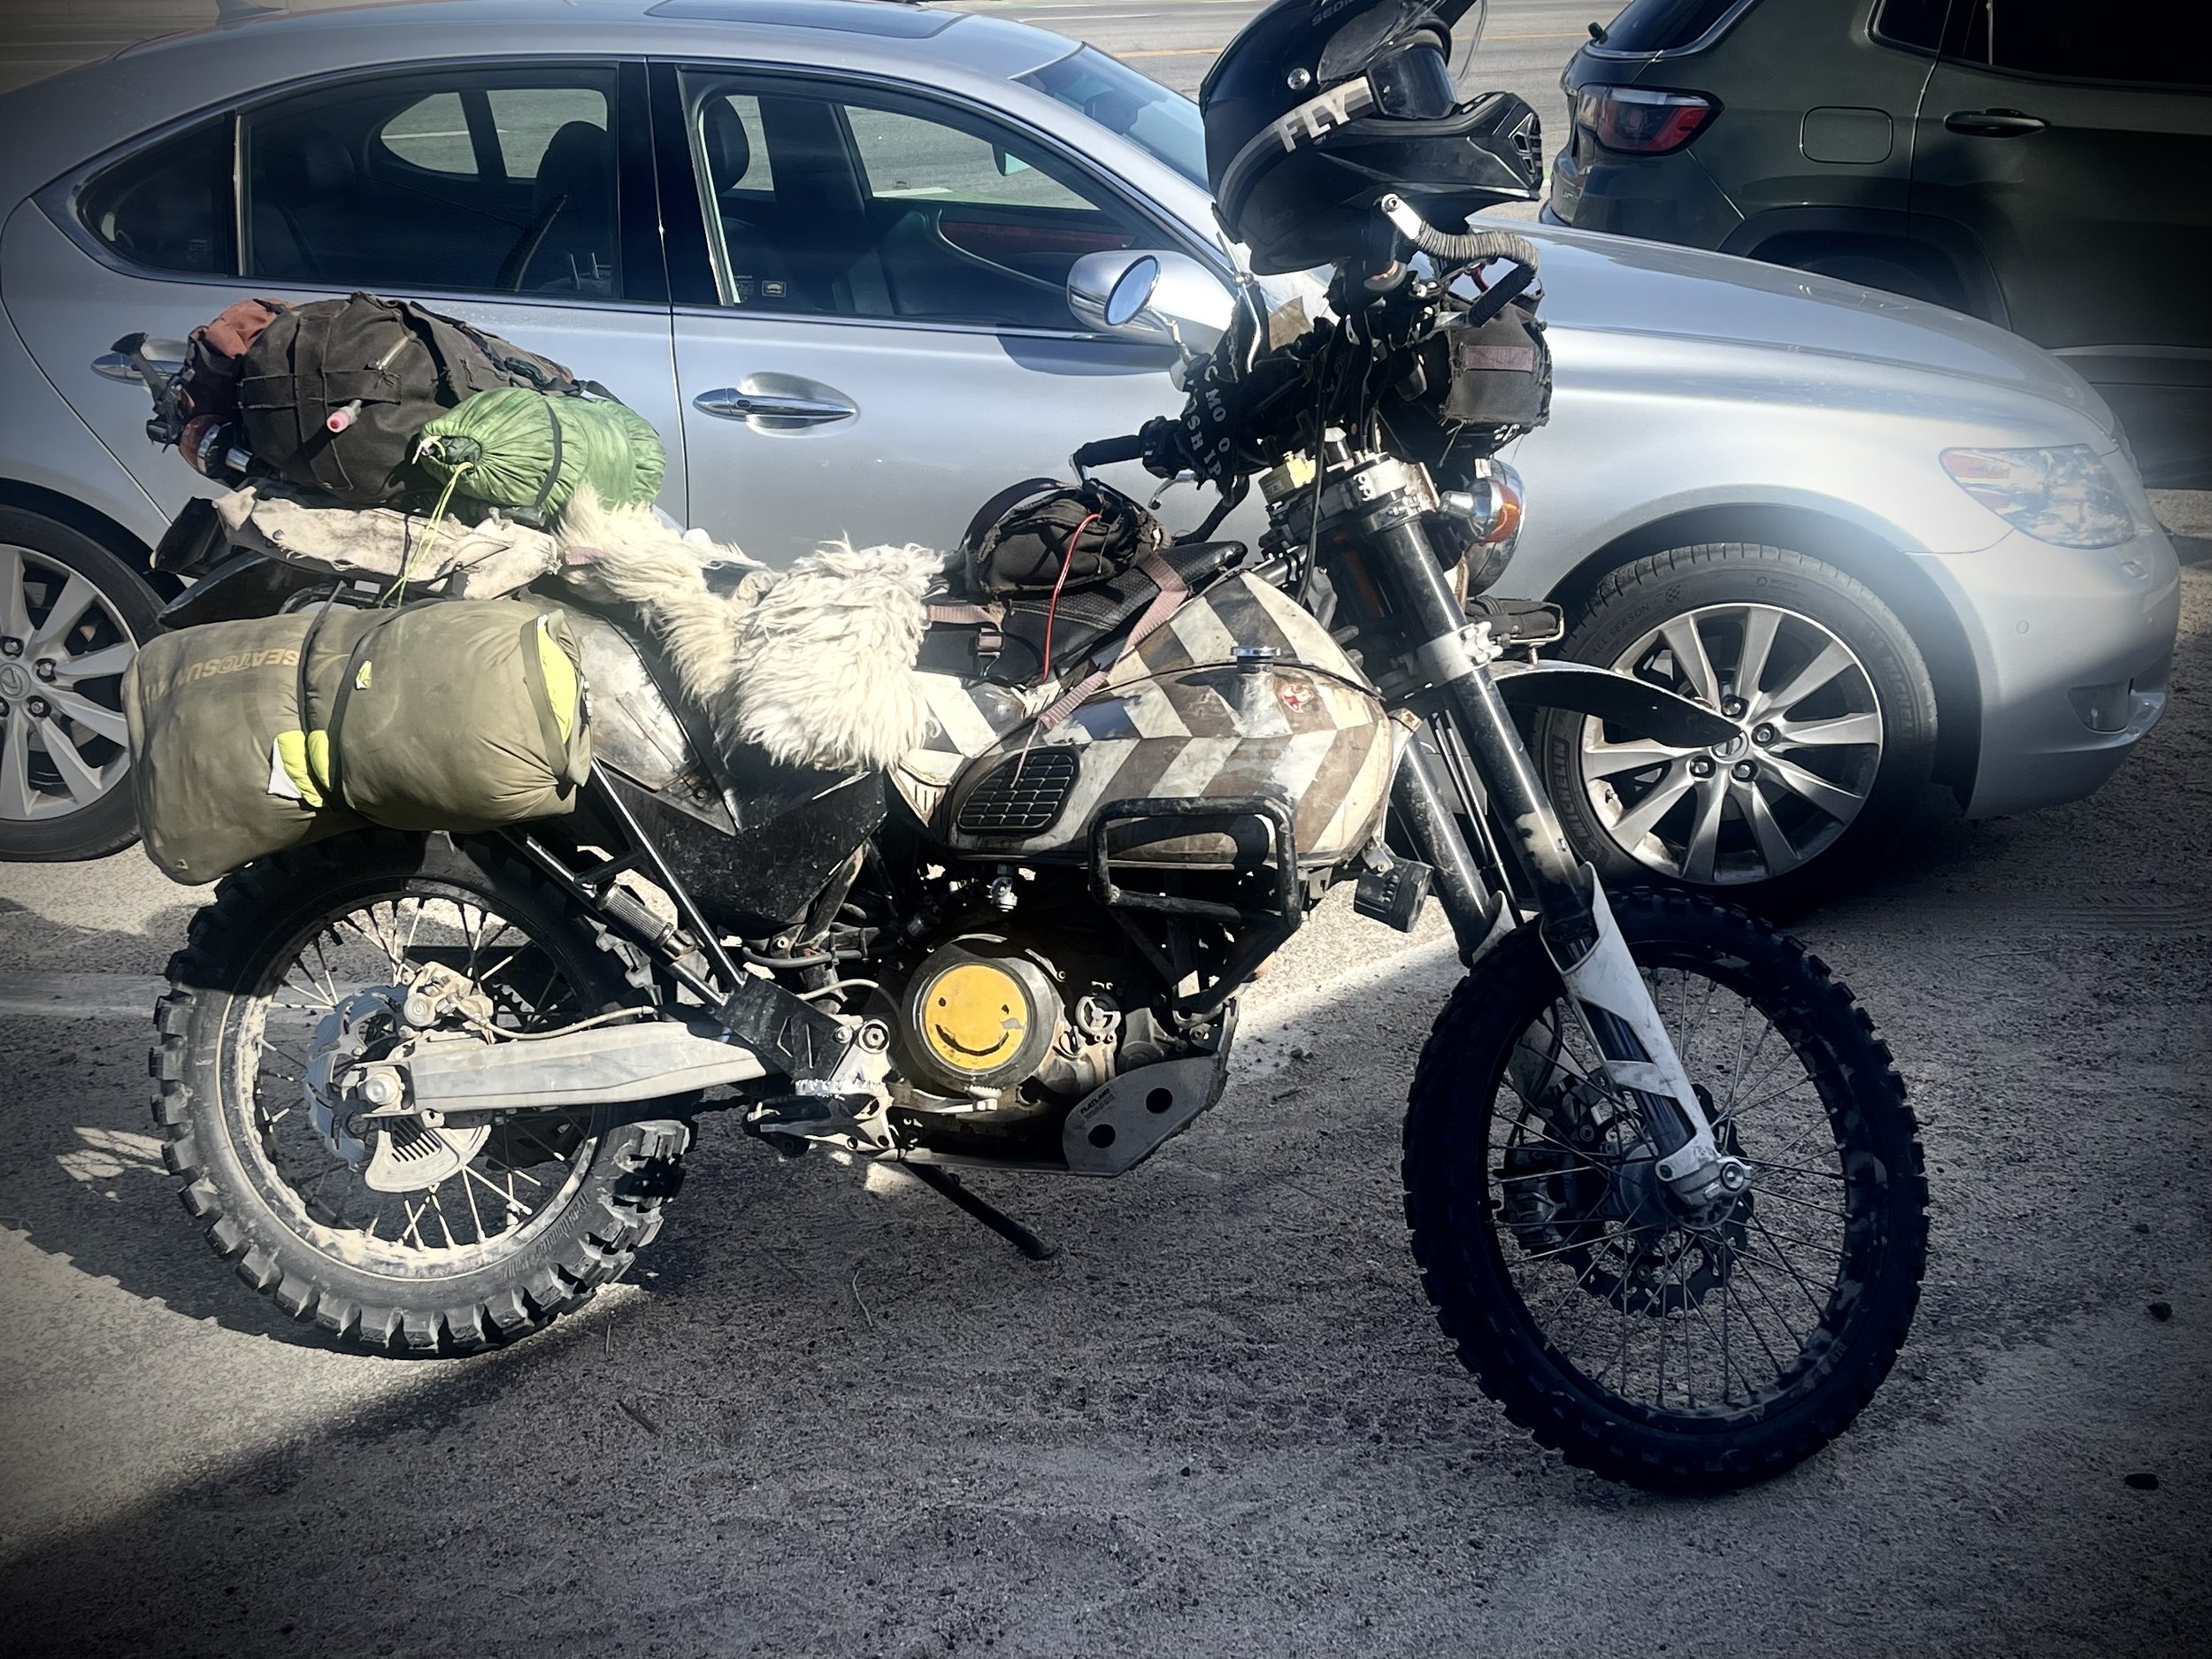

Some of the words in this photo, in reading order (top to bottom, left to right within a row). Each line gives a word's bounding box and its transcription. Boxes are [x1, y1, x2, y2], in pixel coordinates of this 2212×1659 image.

[1276, 81, 1352, 153] FLY
[1609, 603, 1650, 635] SEASON
[1551, 739, 1590, 840] MICHELIN
